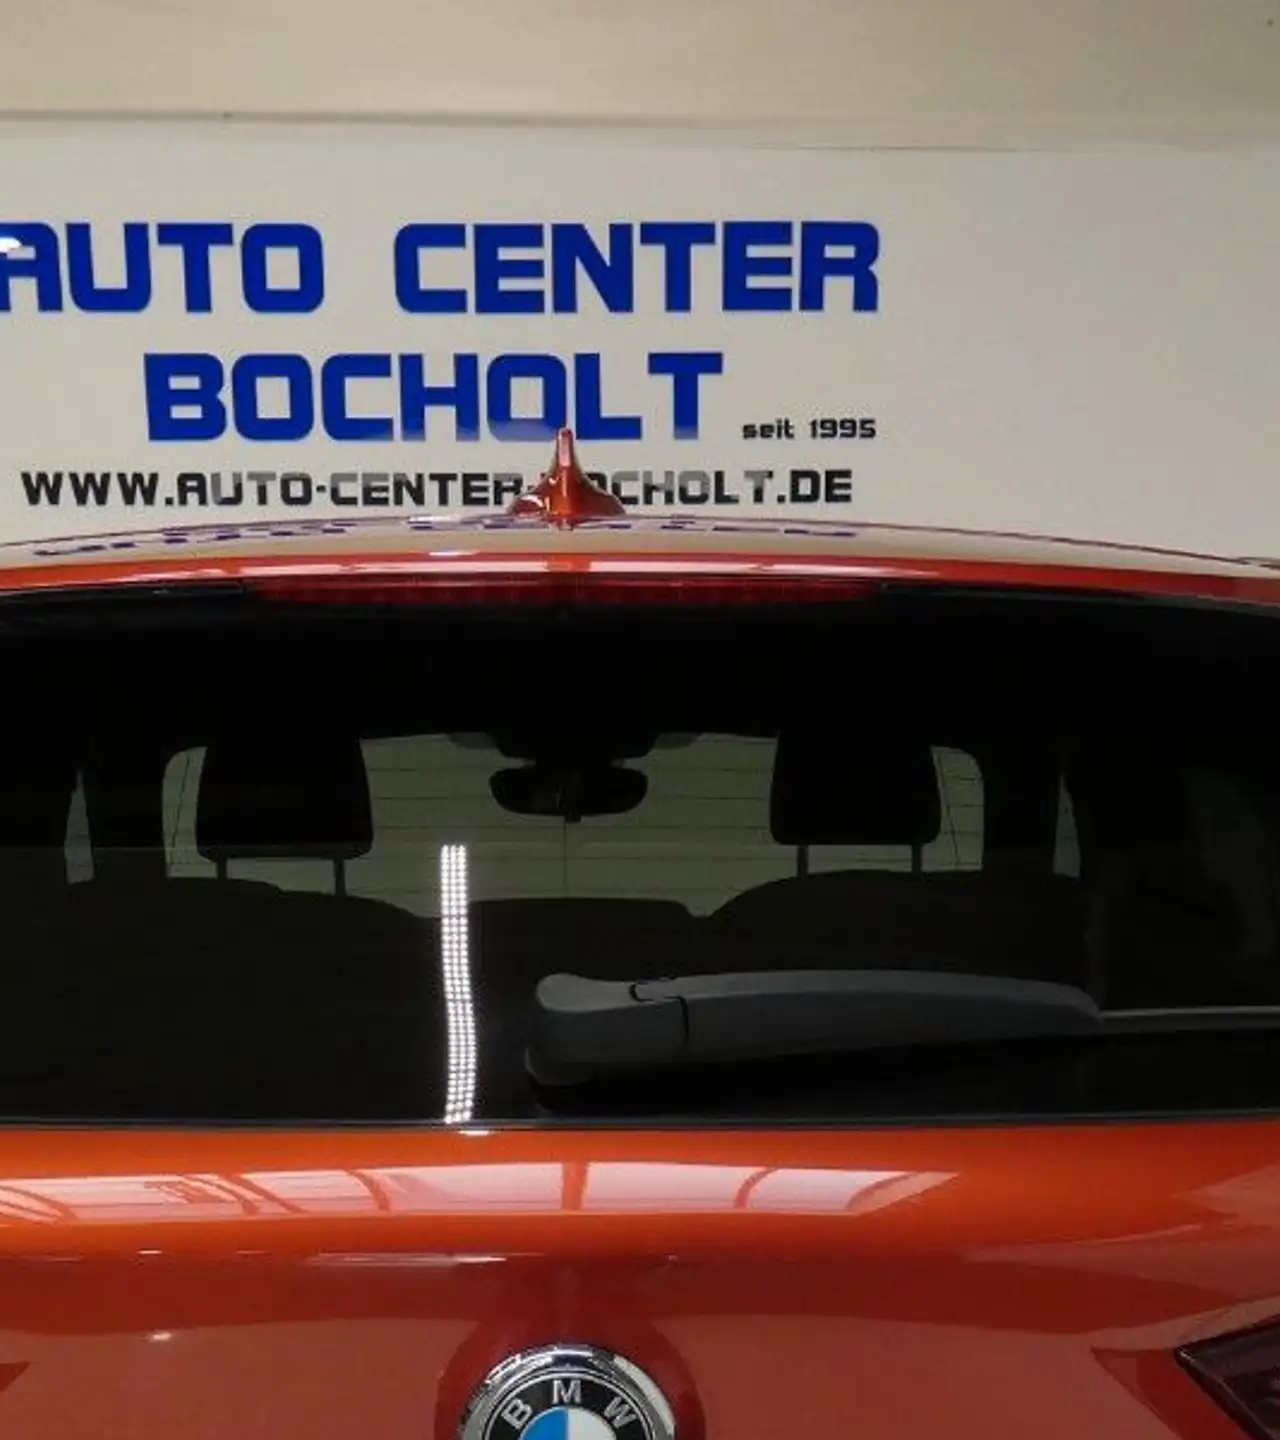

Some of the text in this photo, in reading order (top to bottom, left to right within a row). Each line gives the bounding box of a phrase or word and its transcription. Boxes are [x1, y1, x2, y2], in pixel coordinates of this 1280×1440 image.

[394, 220, 881, 313] CENTER
[144, 351, 877, 442] BOCHOLT seit 1995
[500, 1379, 639, 1430] BMW
